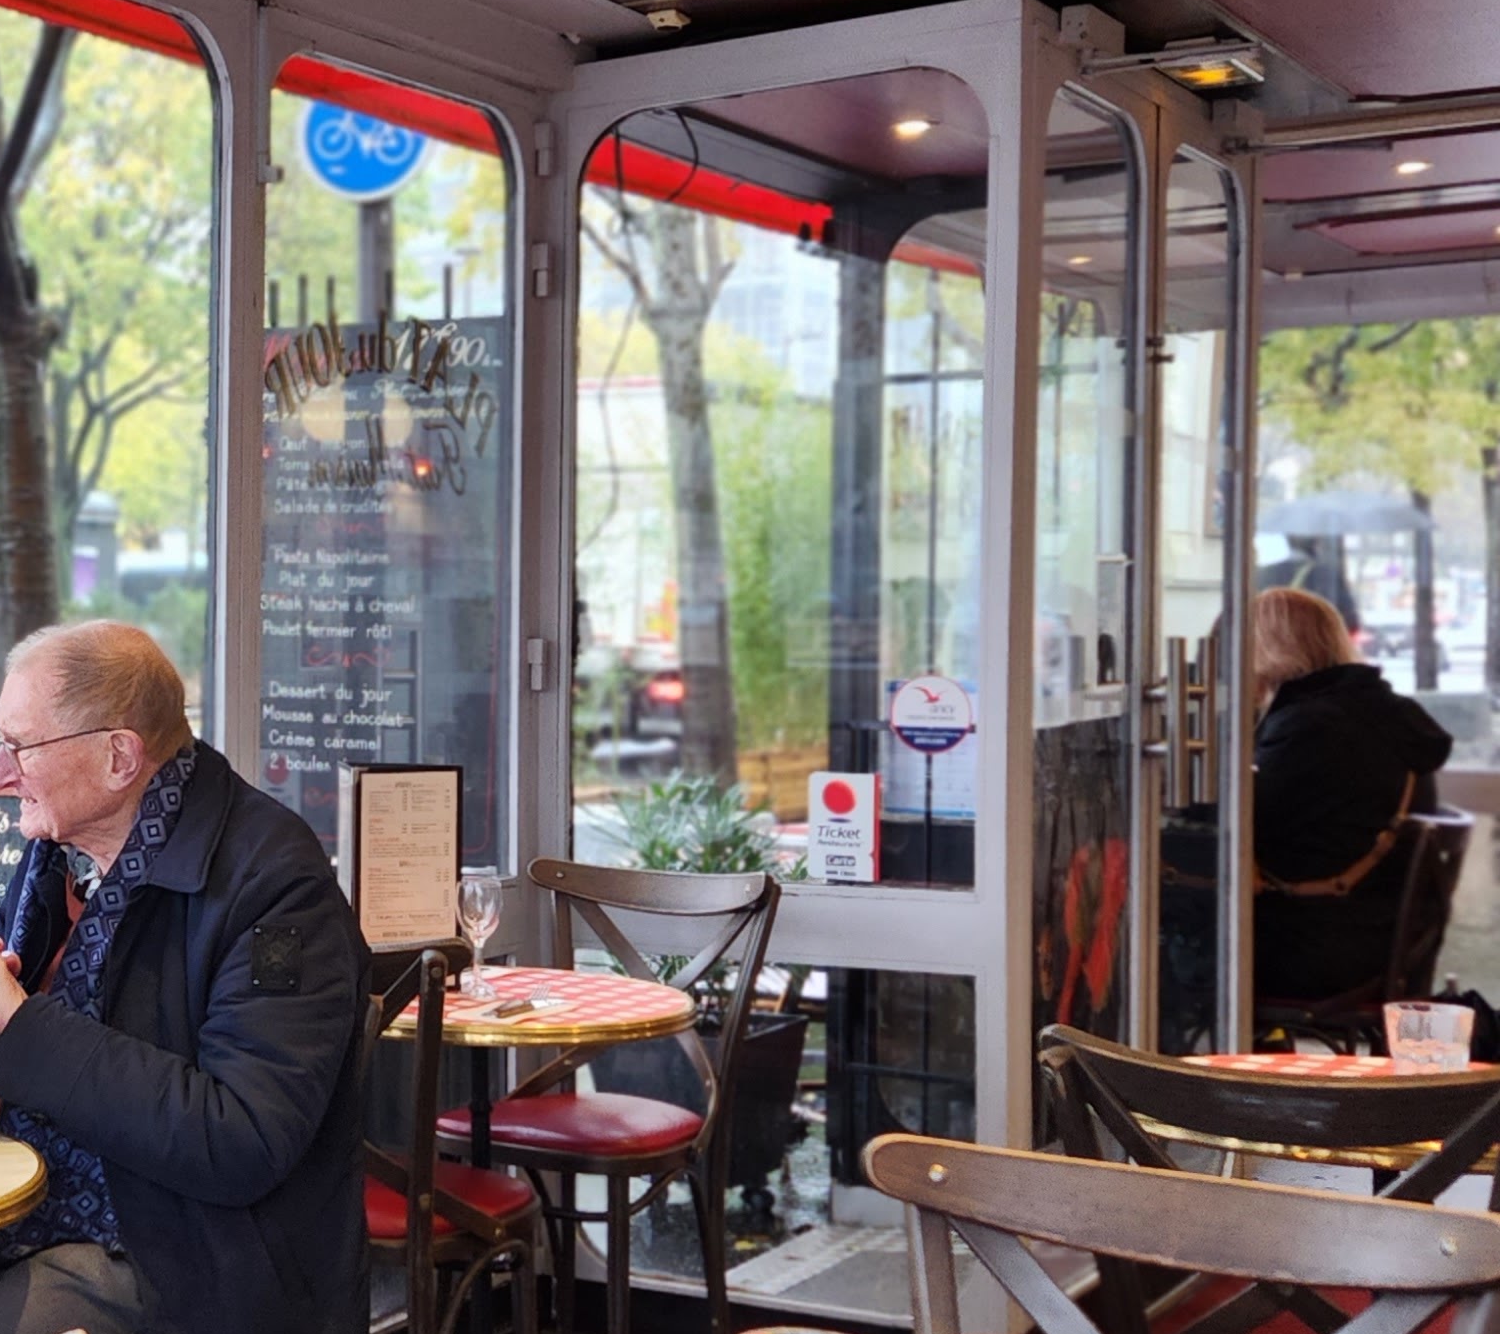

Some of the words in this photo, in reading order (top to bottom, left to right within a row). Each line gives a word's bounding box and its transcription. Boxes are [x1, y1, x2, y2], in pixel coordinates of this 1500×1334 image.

[279, 570, 306, 587] Plat
[317, 571, 334, 588] du
[342, 572, 375, 594] jour
[369, 594, 415, 614] cheval
[262, 619, 301, 636] Poulet
[305, 619, 356, 638] fermier
[269, 680, 326, 699] Dessert
[335, 683, 353, 701] du
[359, 683, 392, 708] jour
[262, 703, 314, 723] Mousse
[322, 713, 337, 724] au
[343, 709, 404, 728] chocolat
[324, 733, 381, 750] caramel
[270, 752, 279, 769] 2
[285, 755, 332, 772] boules
[817, 825, 862, 840] Ticket
